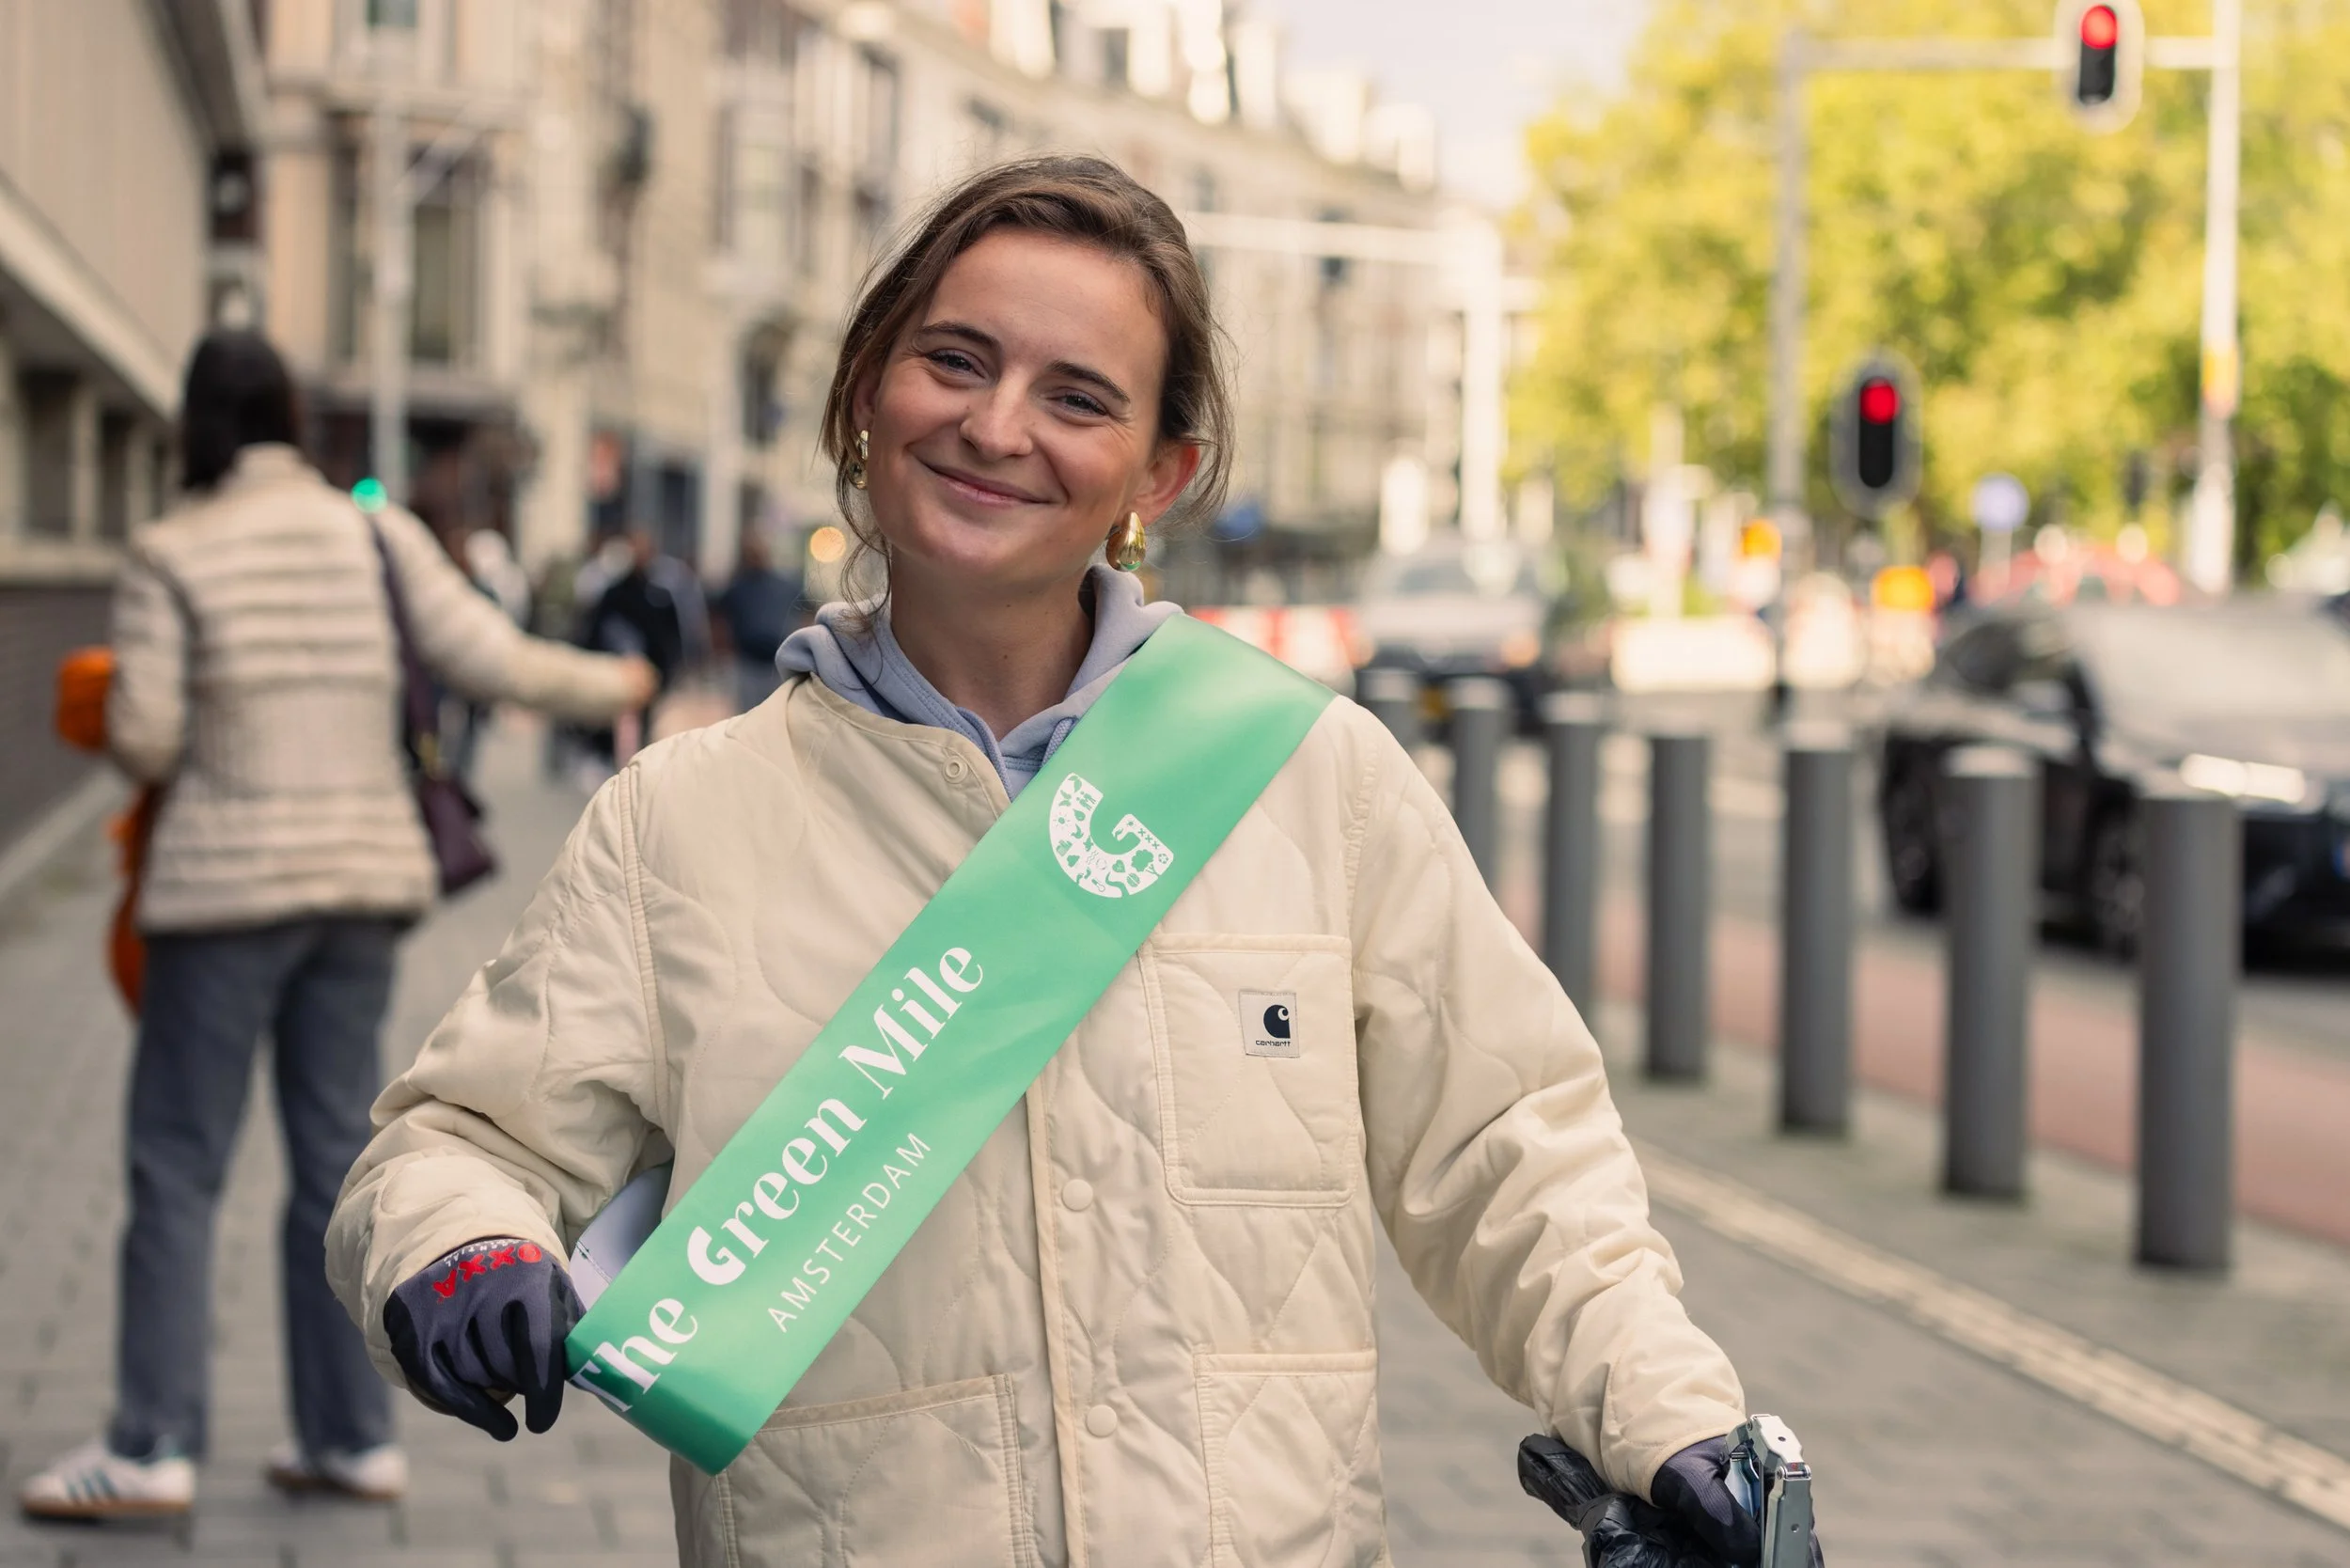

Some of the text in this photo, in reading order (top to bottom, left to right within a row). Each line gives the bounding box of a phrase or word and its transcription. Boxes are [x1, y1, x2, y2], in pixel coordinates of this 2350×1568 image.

[432, 1243, 542, 1297] OXXA
[569, 947, 983, 1412] The Green Mile
[767, 1133, 931, 1332] AMSTERDAM
